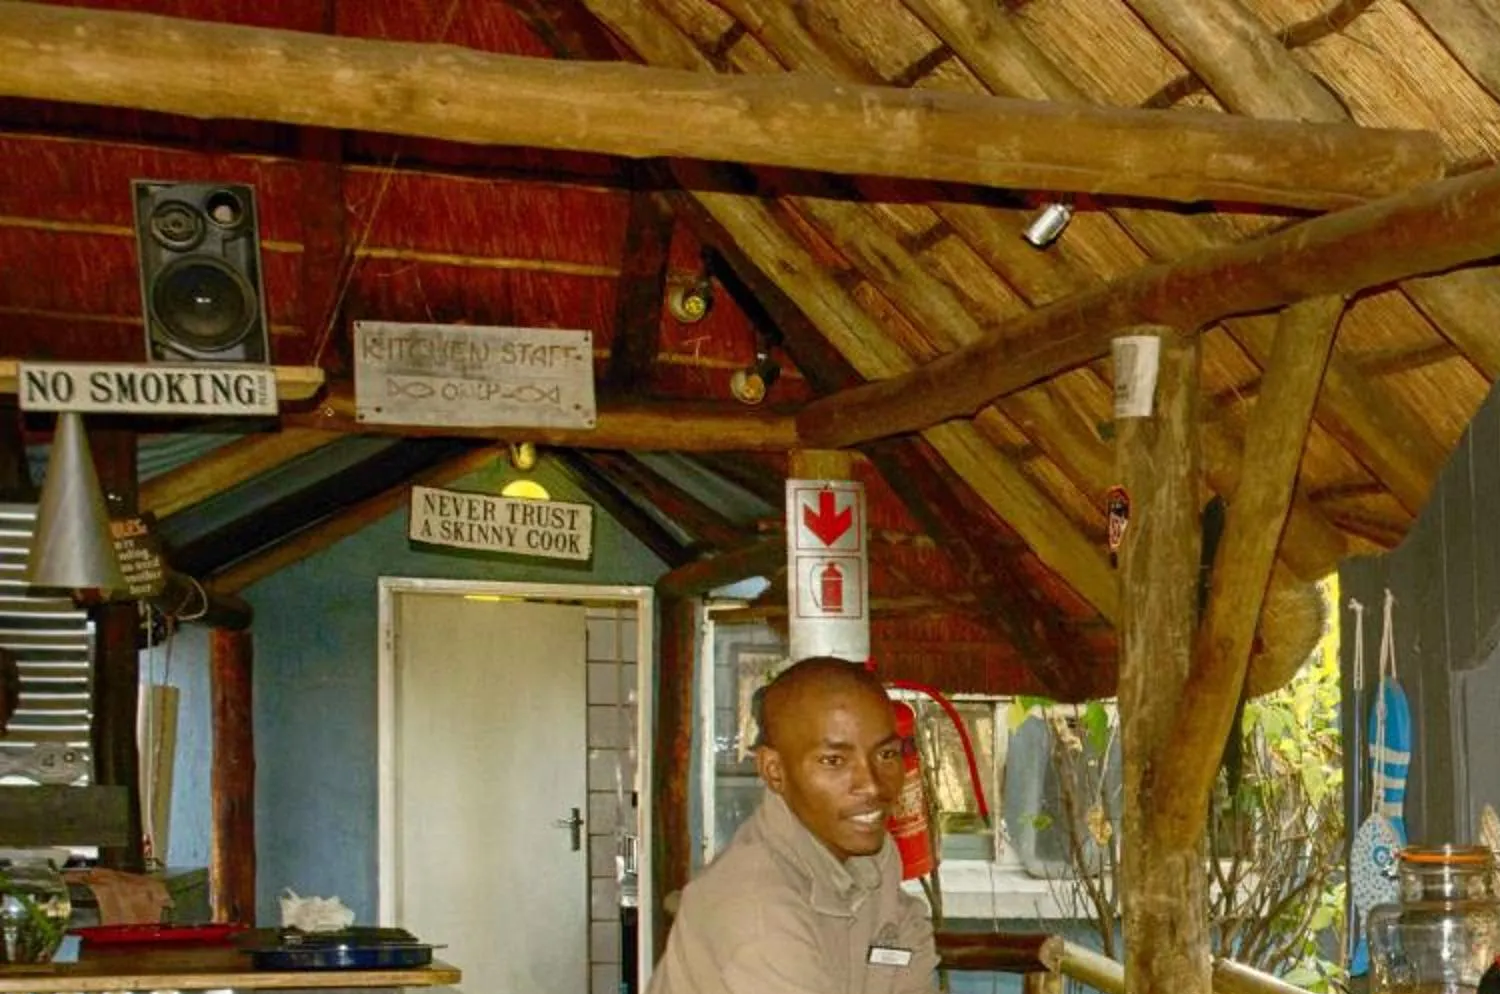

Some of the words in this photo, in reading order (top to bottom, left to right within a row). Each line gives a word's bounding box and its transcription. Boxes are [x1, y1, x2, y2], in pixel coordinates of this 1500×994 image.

[26, 369, 72, 401] NO
[89, 371, 255, 405] SMOKING
[424, 493, 496, 522] NEVER
[506, 502, 579, 531] TRUST
[421, 518, 432, 537] A
[439, 520, 518, 548] SKINNY
[526, 529, 581, 554] COOK
